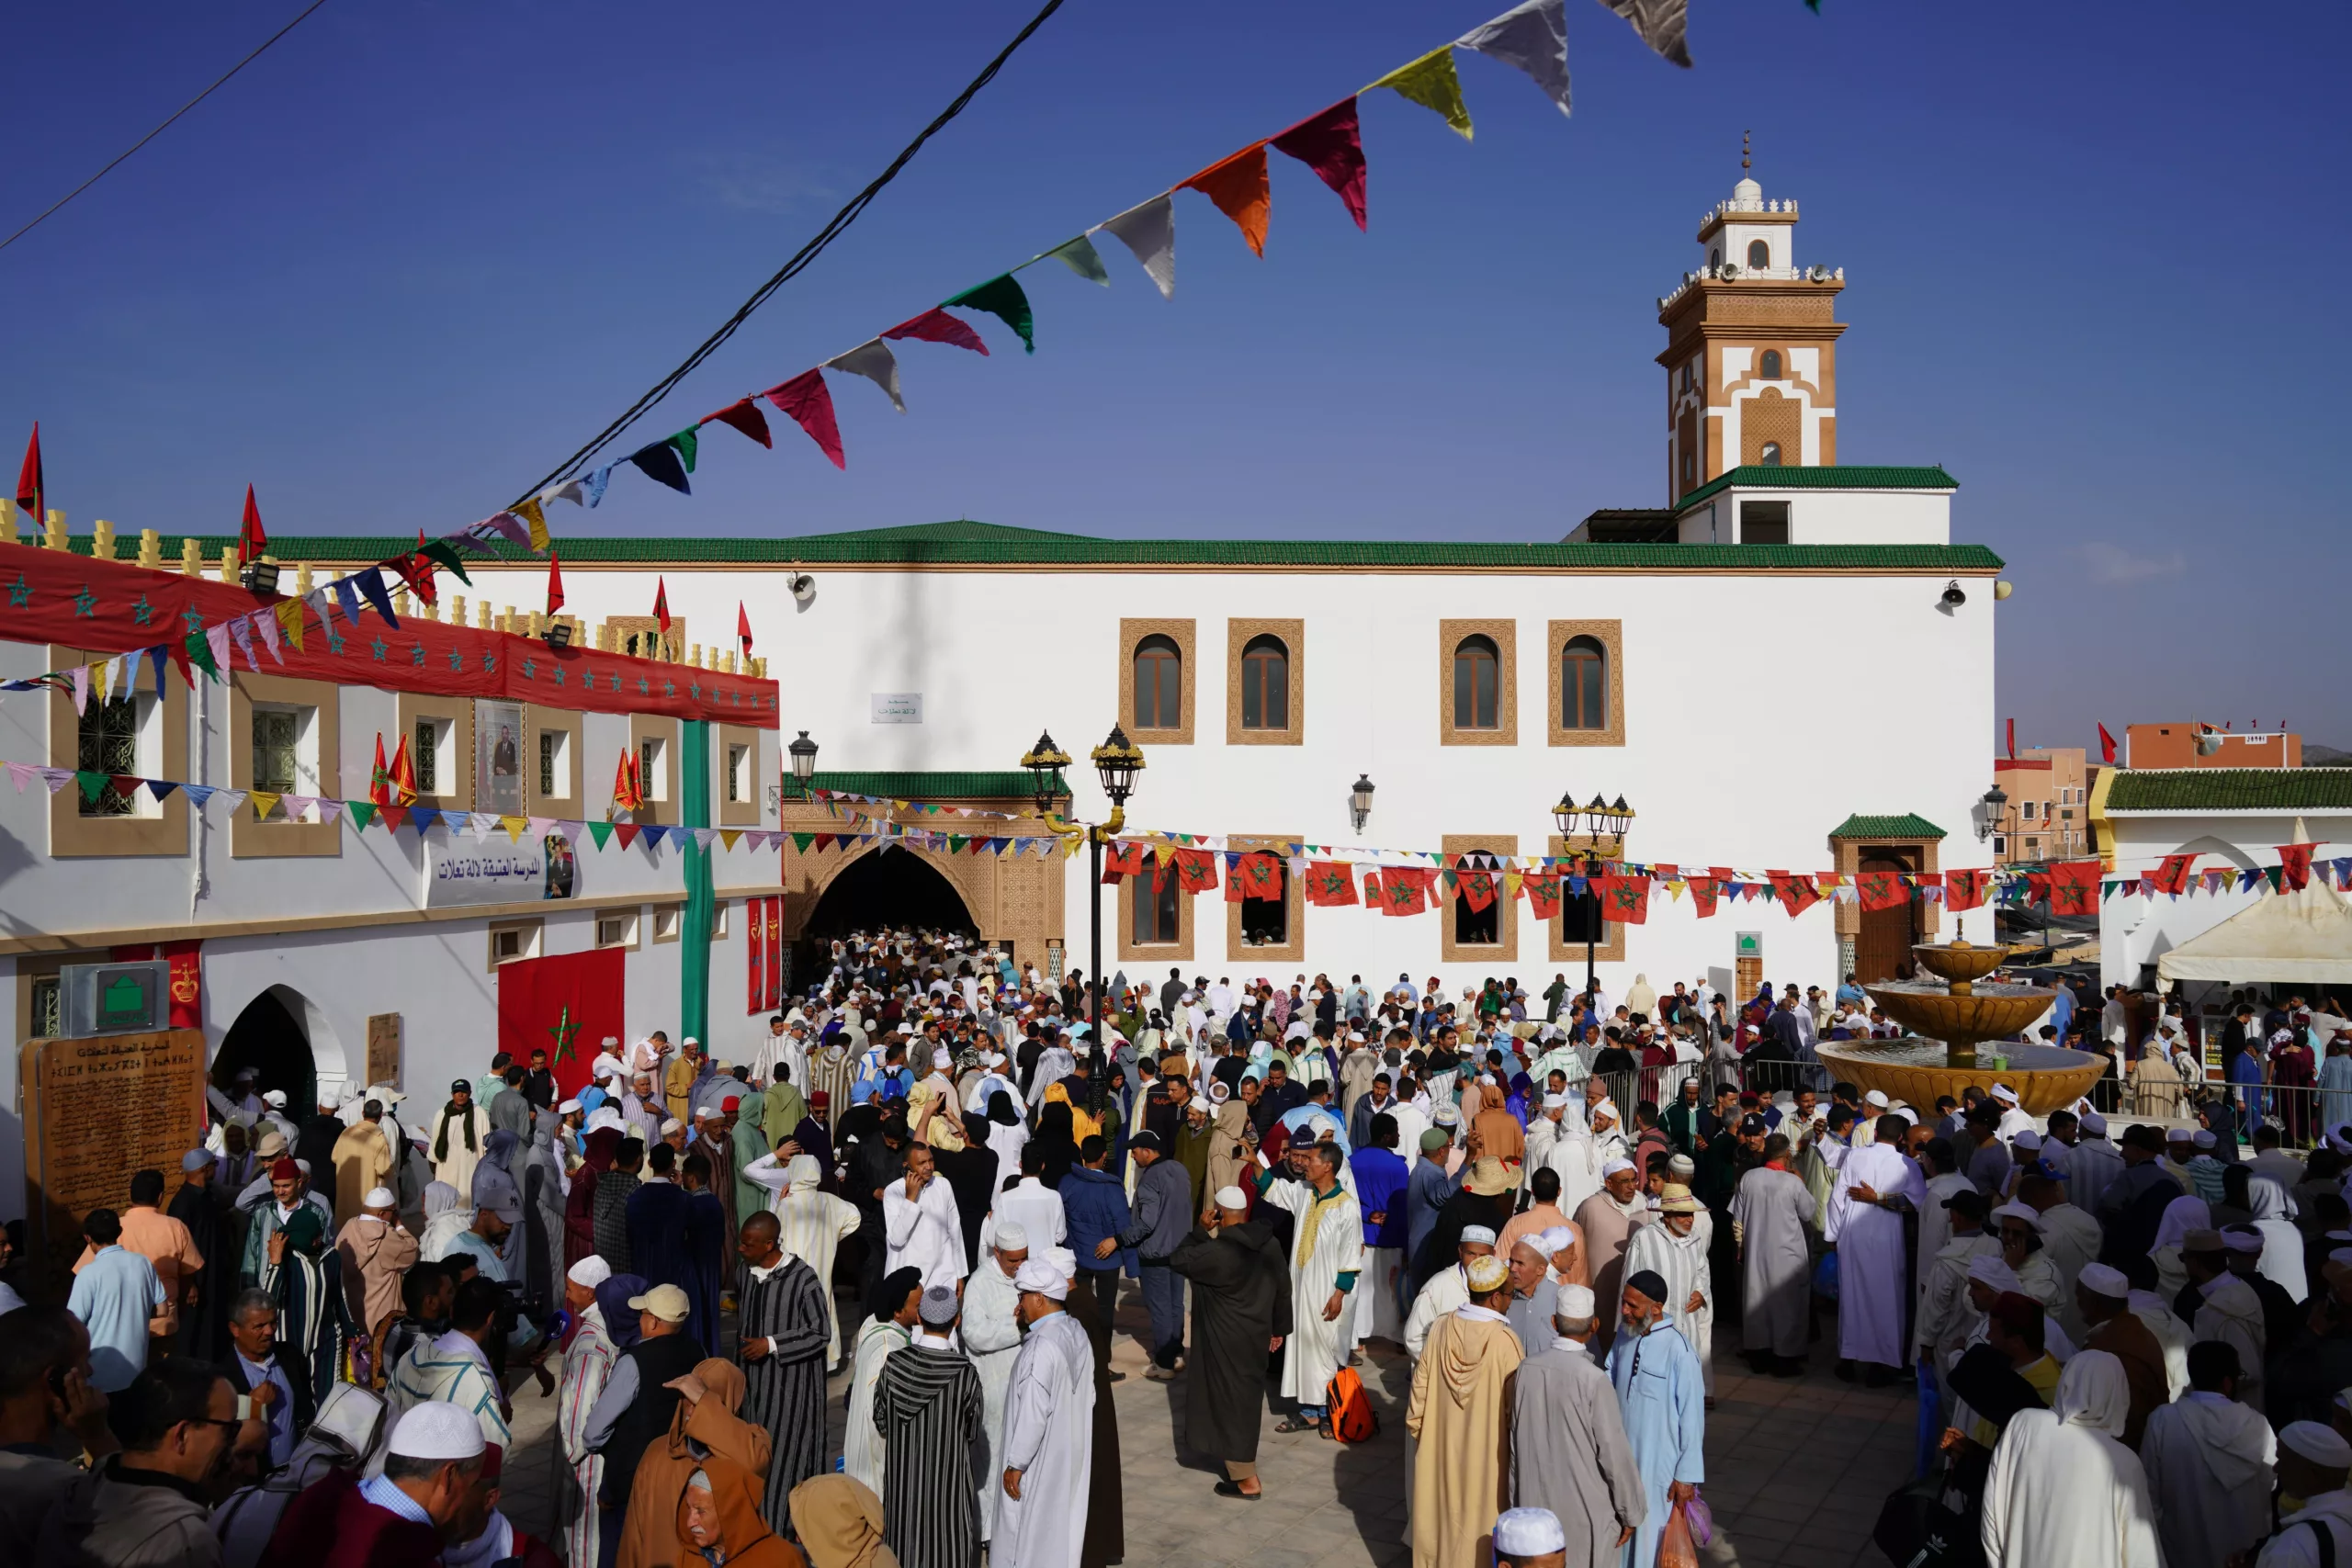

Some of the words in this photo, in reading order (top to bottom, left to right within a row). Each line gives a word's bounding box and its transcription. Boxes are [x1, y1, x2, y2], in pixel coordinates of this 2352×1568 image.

[438, 859, 465, 881] تعلات
[466, 859, 481, 878] لالة
[483, 858, 512, 882] العتيقة
[513, 857, 540, 882] المدرسة
[141, 1041, 170, 1055] المدرسة
